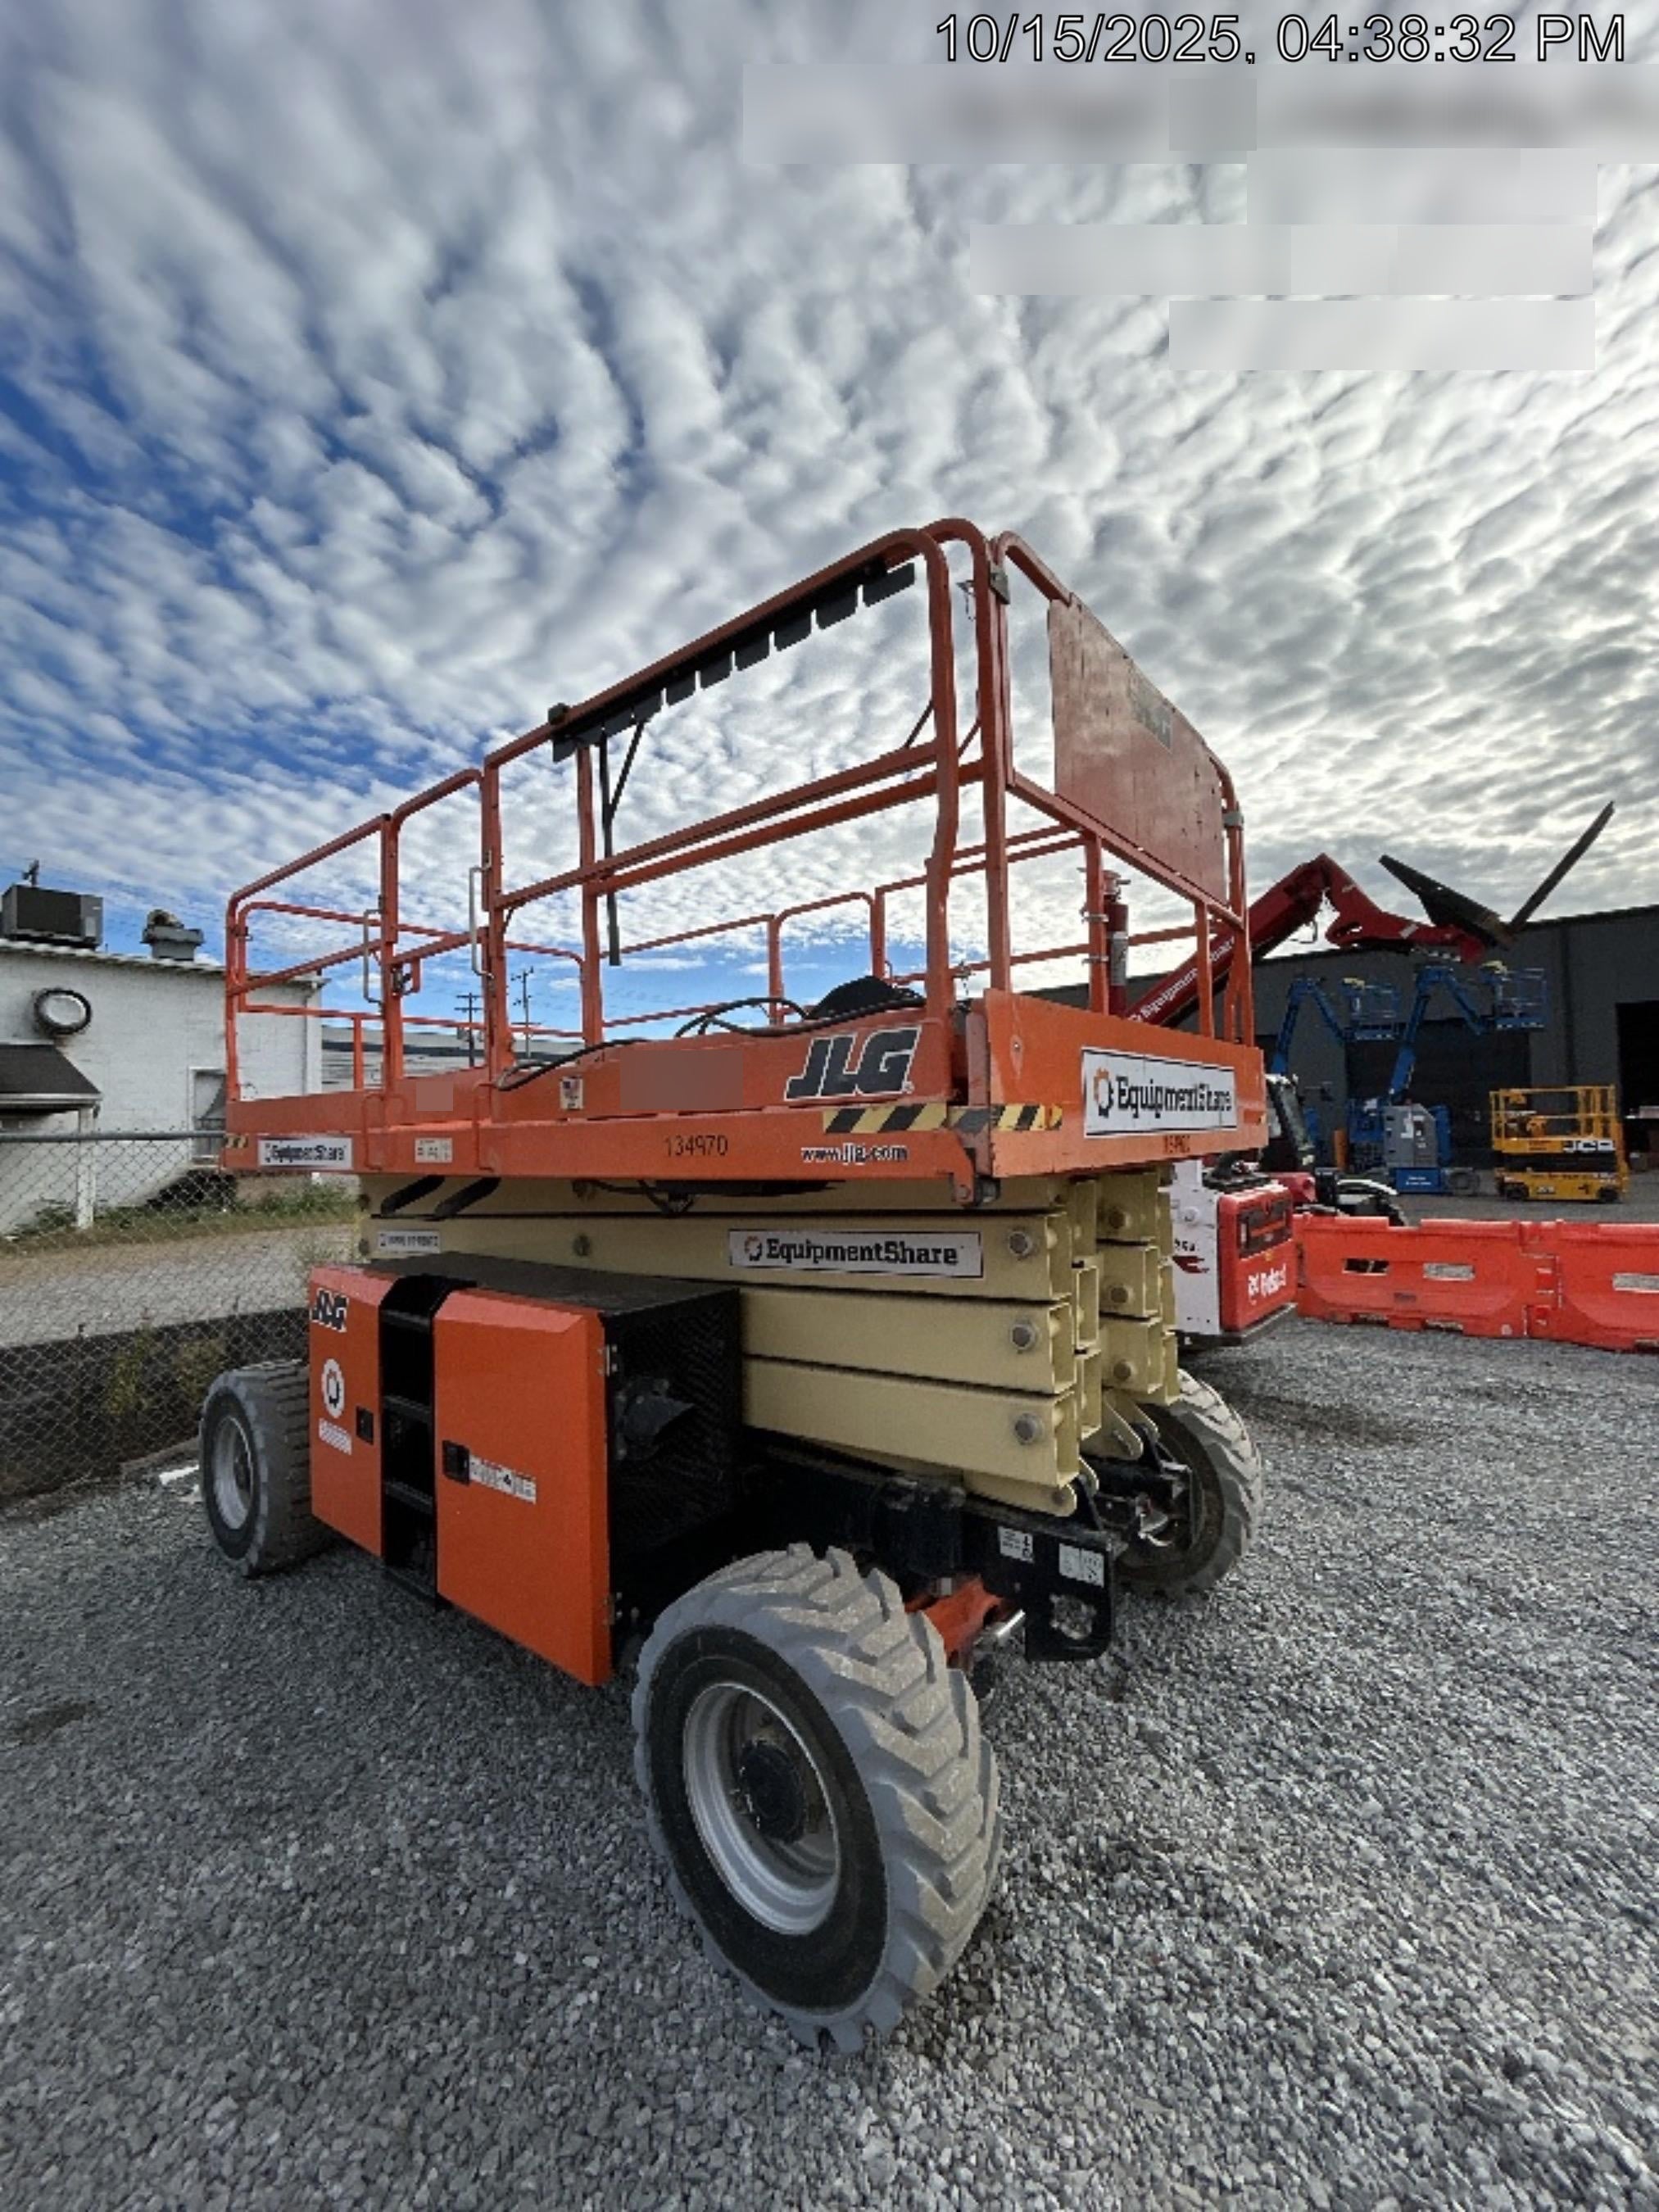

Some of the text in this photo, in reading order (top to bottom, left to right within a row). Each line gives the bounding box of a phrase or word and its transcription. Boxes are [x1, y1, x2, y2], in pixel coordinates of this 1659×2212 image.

[784, 1025, 922, 1101] JLG
[663, 1134, 728, 1157] 134970
[766, 1237, 959, 1266] EquipmentShare
